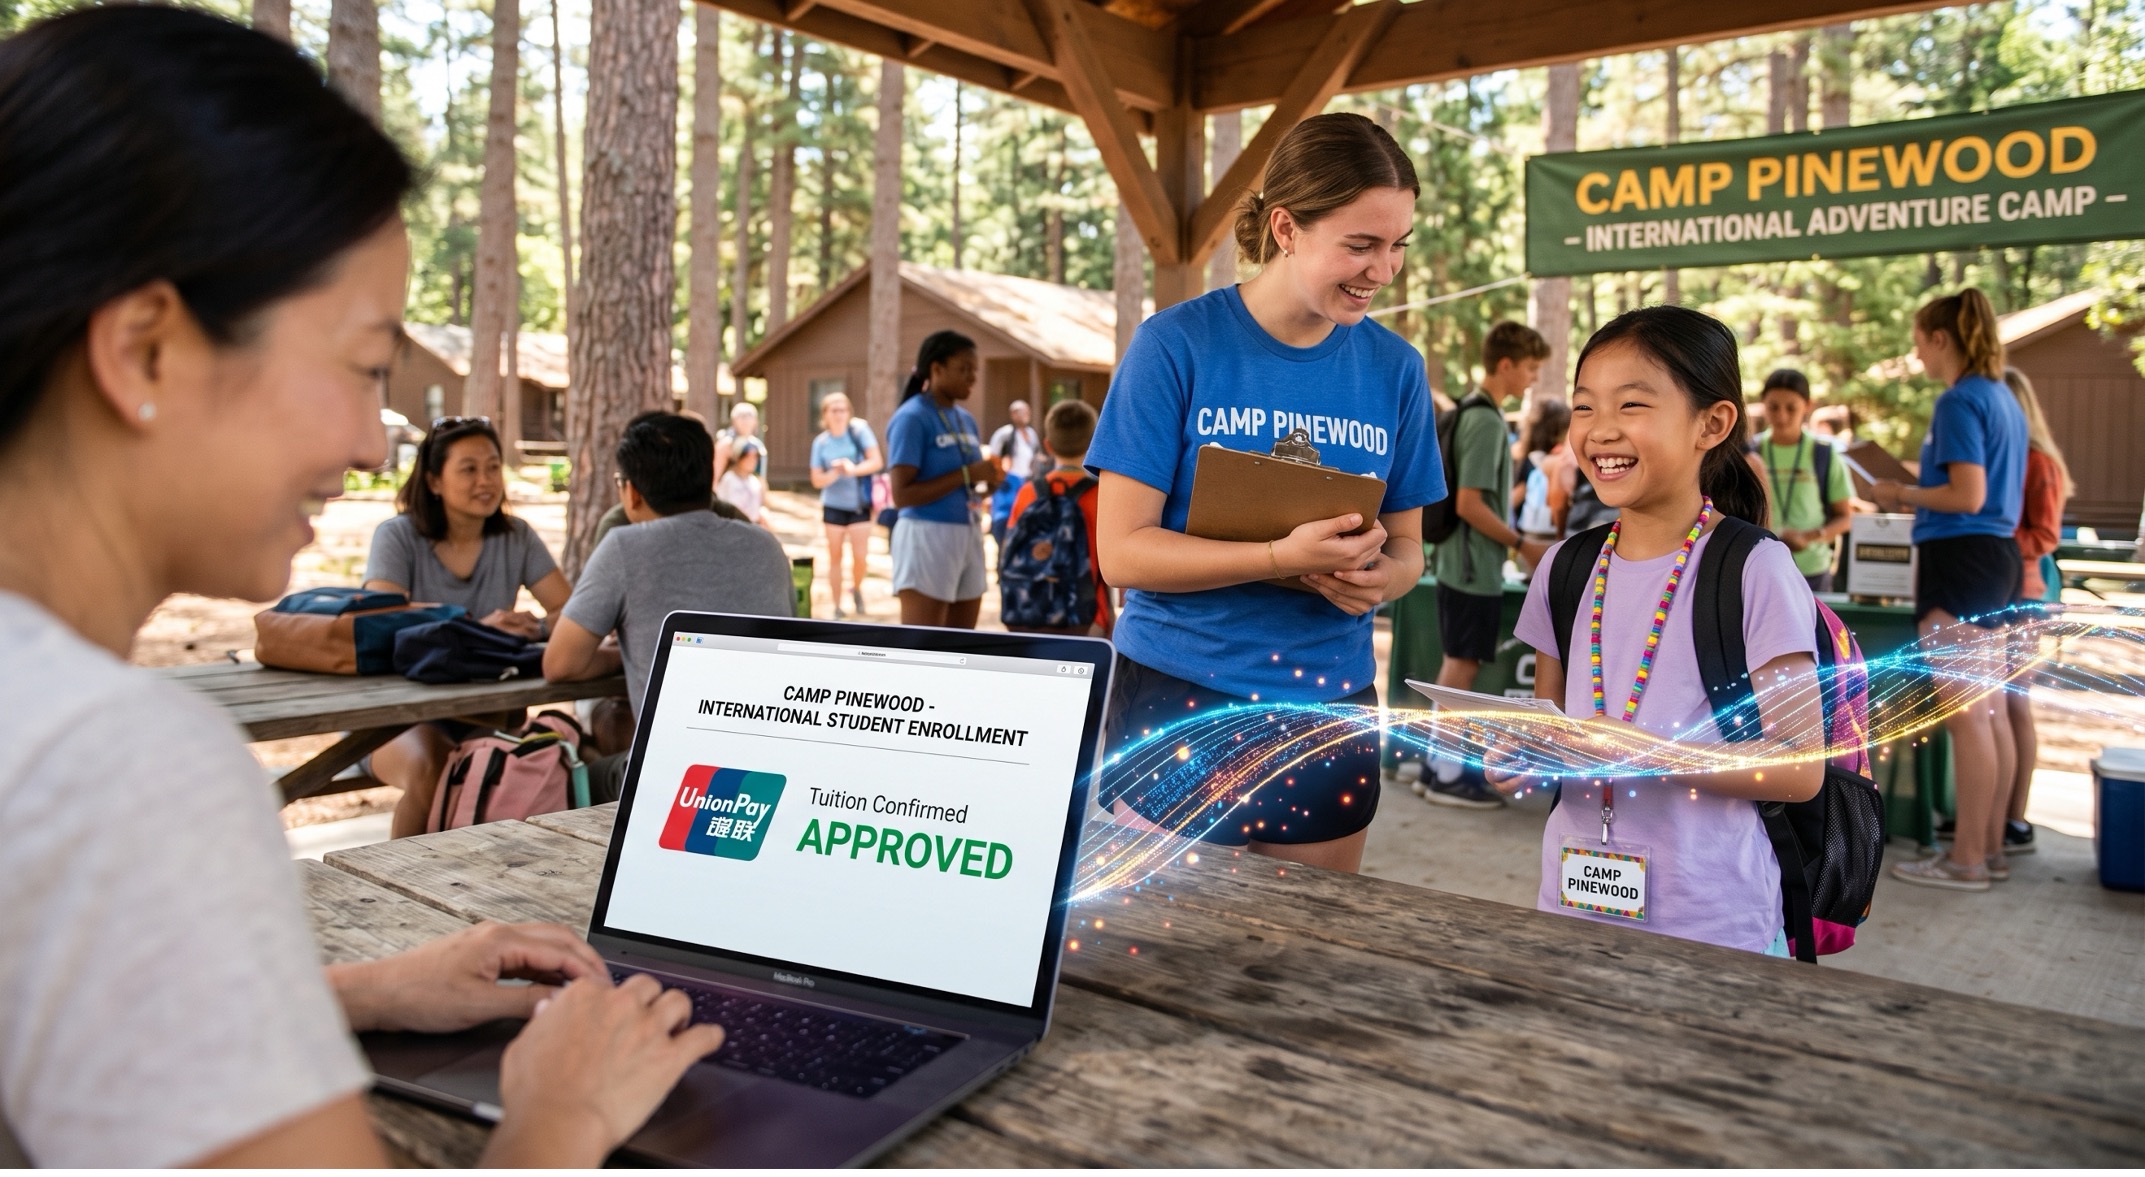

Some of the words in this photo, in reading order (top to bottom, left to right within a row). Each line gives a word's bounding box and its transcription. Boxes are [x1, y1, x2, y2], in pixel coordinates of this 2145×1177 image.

[1576, 162, 1733, 215] CAMP
[1748, 126, 2097, 201] PINEWOOD
[1585, 209, 1801, 252] INTERNATIONAL
[1806, 194, 1991, 236] ADVENTURE
[1998, 185, 2098, 222] CAMP
[1197, 407, 1267, 436] CAMP
[1273, 410, 1388, 456] PINEWOOD
[783, 685, 832, 704] CAMP
[834, 690, 925, 713] PINEWOOD
[698, 699, 822, 727] INTERNATIONAL
[826, 712, 906, 734] STUDENT
[907, 720, 1029, 747] ENROLLMENT
[679, 786, 771, 829] UnionPay
[809, 786, 868, 811] Tuition
[872, 794, 969, 824] Confirmed
[796, 817, 1013, 880] APPROVED
[1568, 877, 1639, 900] PINEWOOD
[1583, 865, 1622, 881] CAMP
